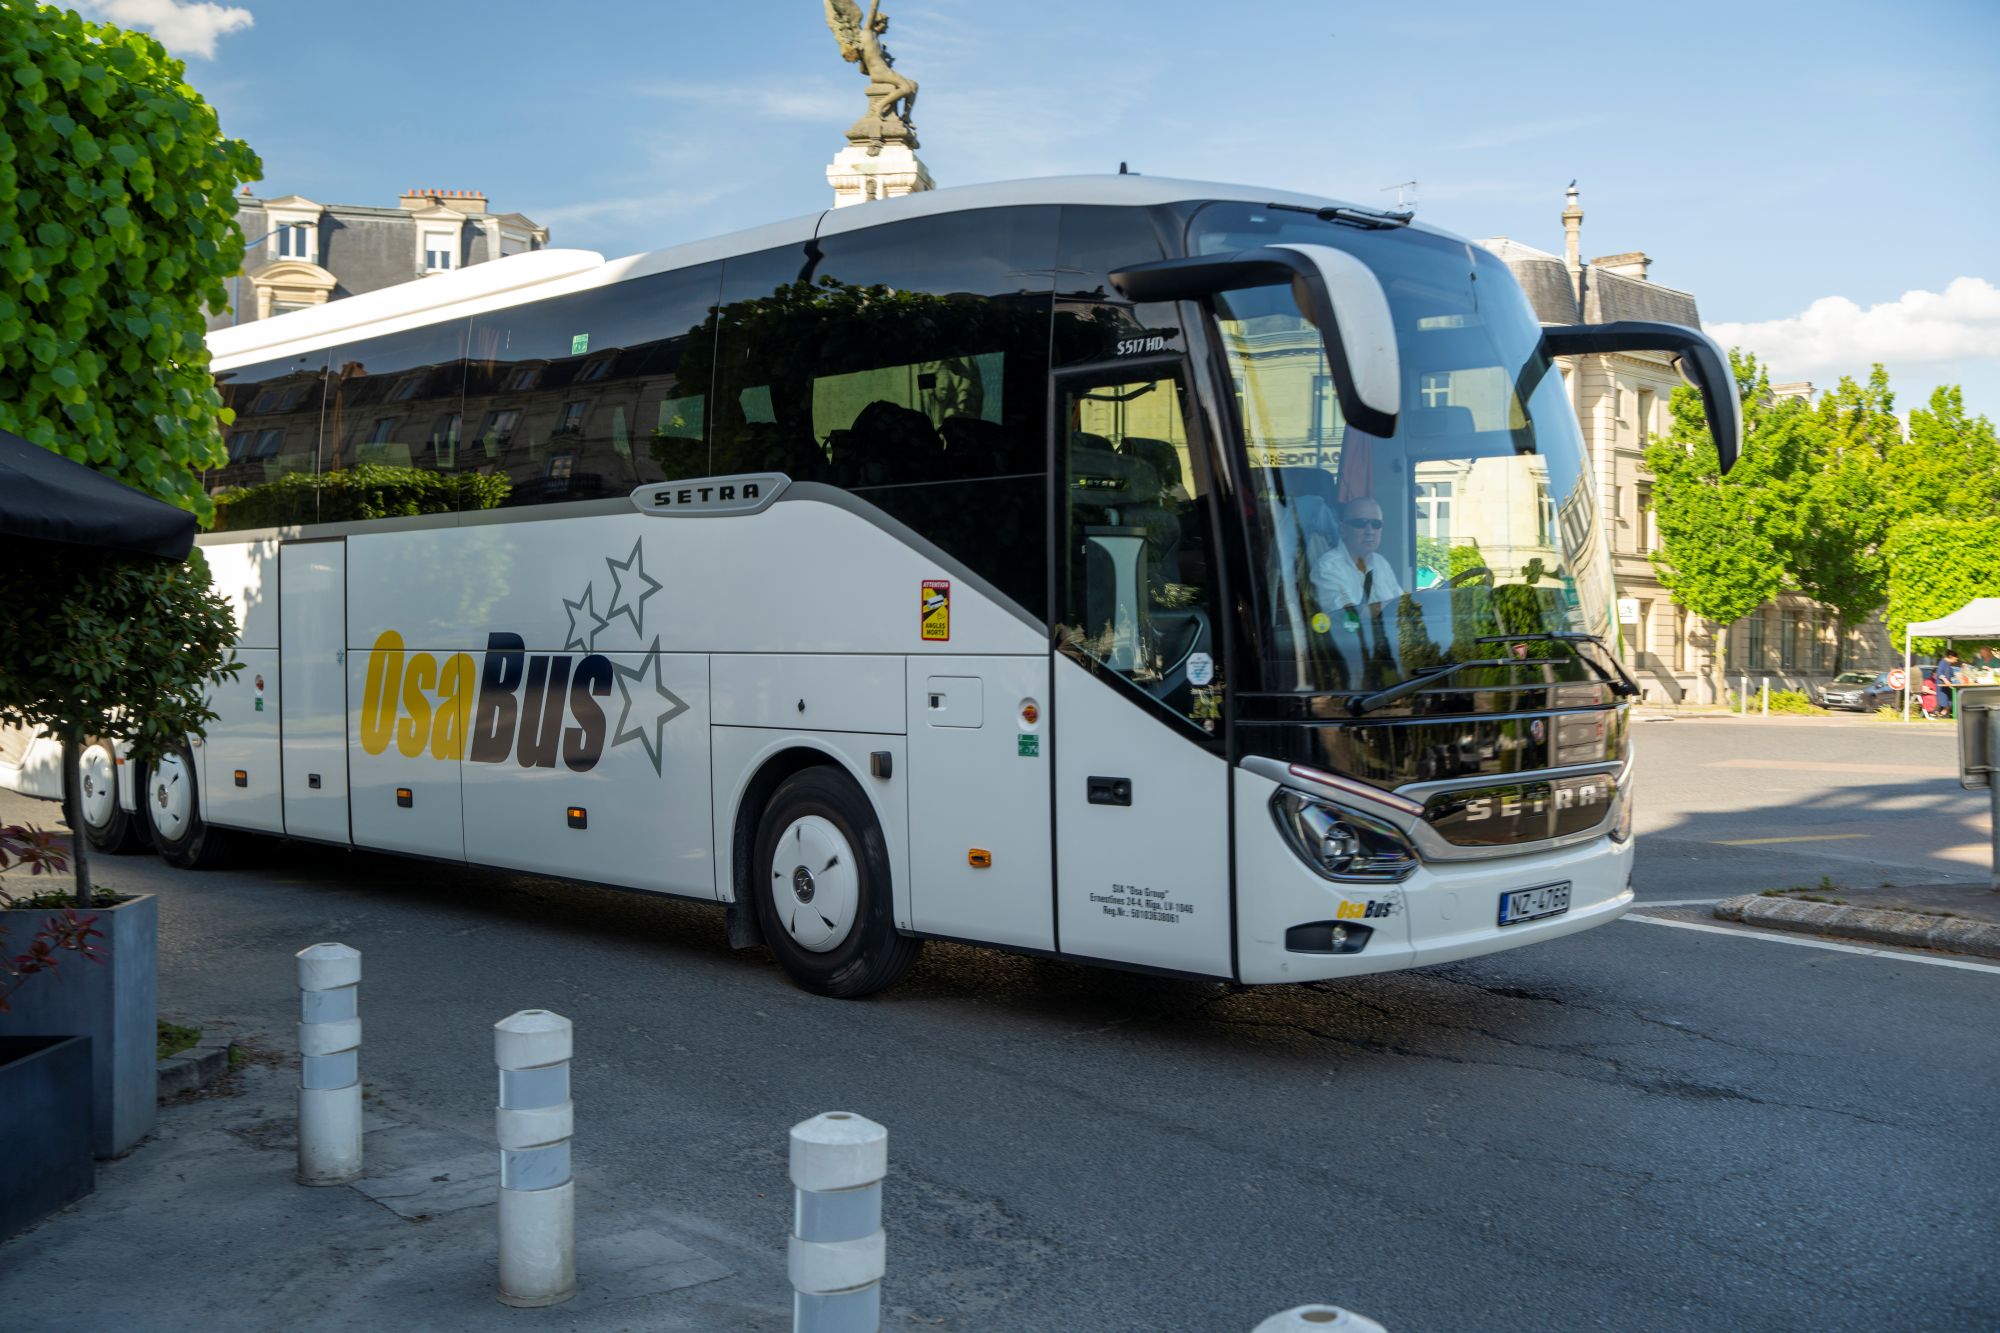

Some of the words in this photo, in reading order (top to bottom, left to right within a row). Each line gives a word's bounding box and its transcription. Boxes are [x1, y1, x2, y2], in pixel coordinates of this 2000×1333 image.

[1145, 336, 1164, 352] HD
[654, 484, 759, 506] SETRA
[360, 630, 613, 772] OsaBus
[1466, 784, 1597, 821] SETRA
[1112, 884, 1124, 894] SIA
[1336, 899, 1393, 919] OsaBus
